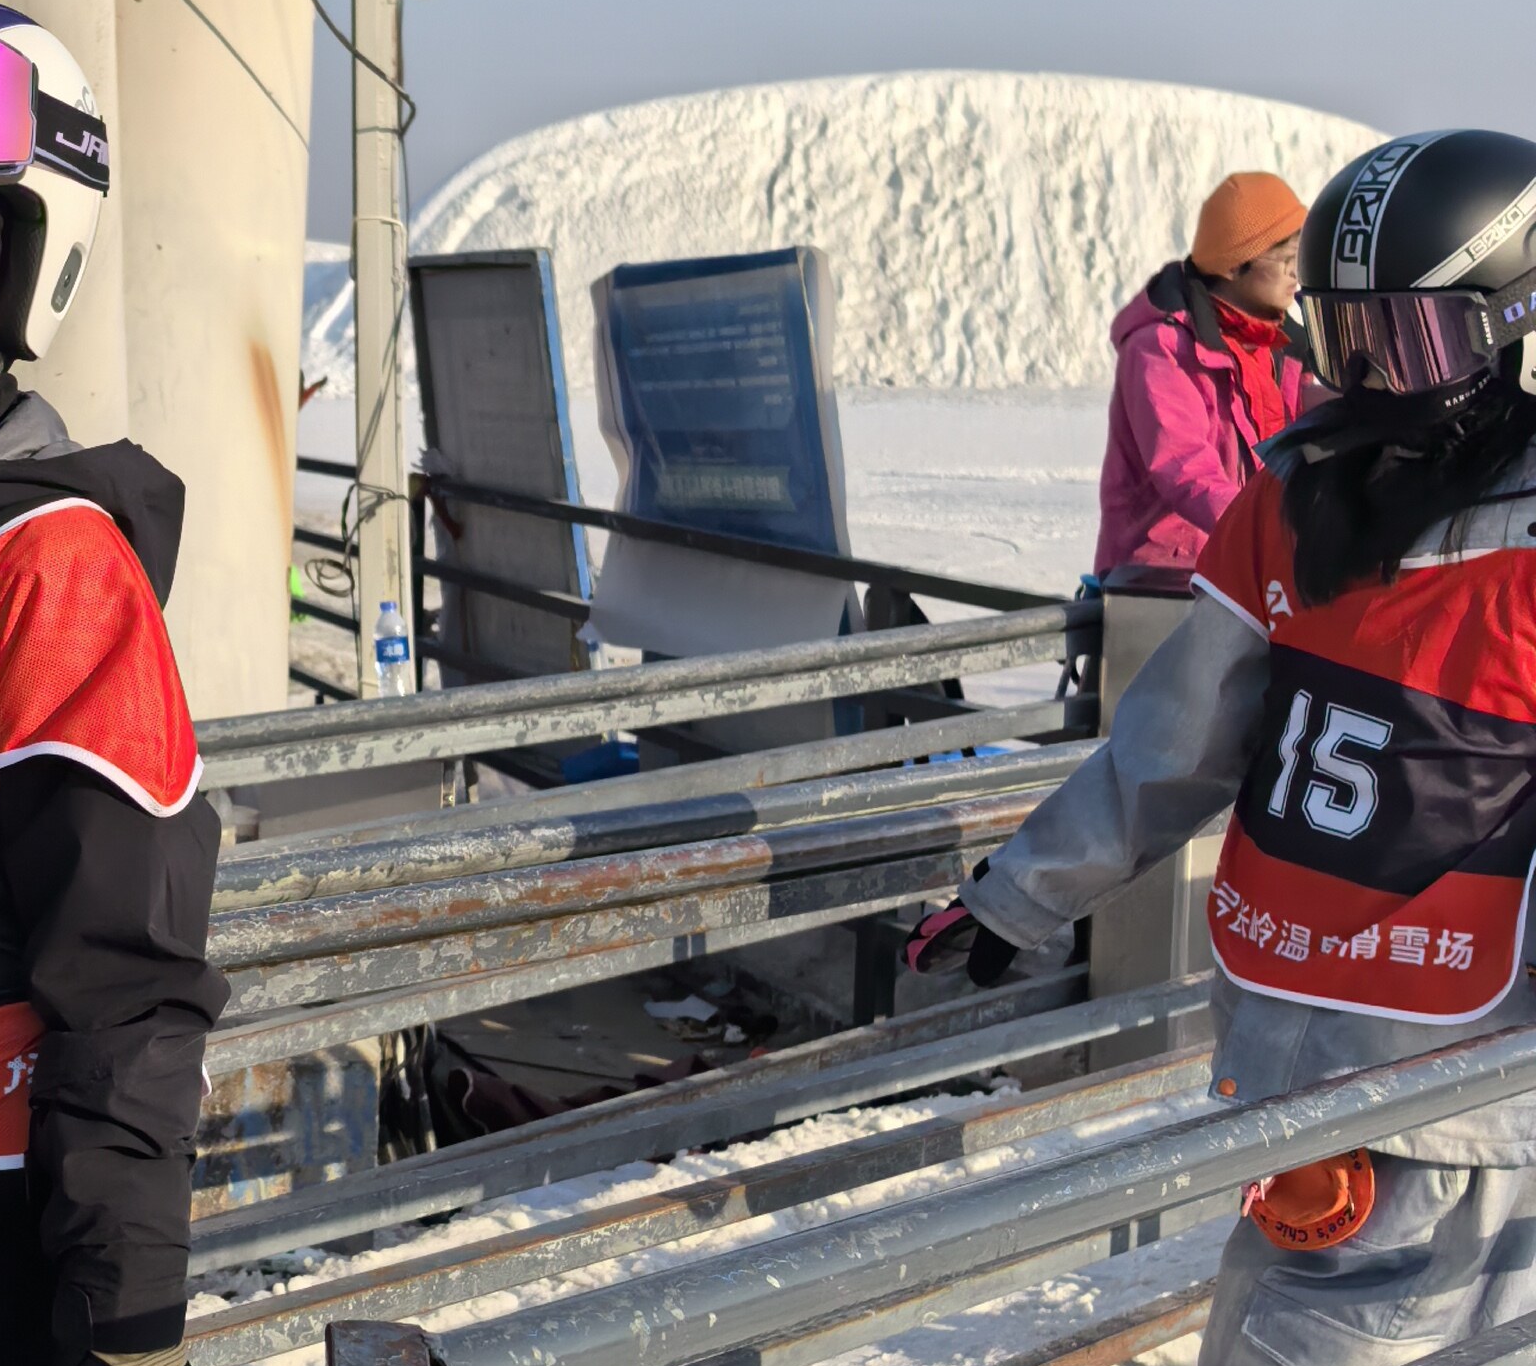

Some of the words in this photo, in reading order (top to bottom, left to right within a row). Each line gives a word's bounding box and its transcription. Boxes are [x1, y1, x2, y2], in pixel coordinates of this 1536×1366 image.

[1337, 143, 1419, 266] BRIKO
[1467, 205, 1525, 260] BRIKO
[1267, 688, 1394, 840] 15
